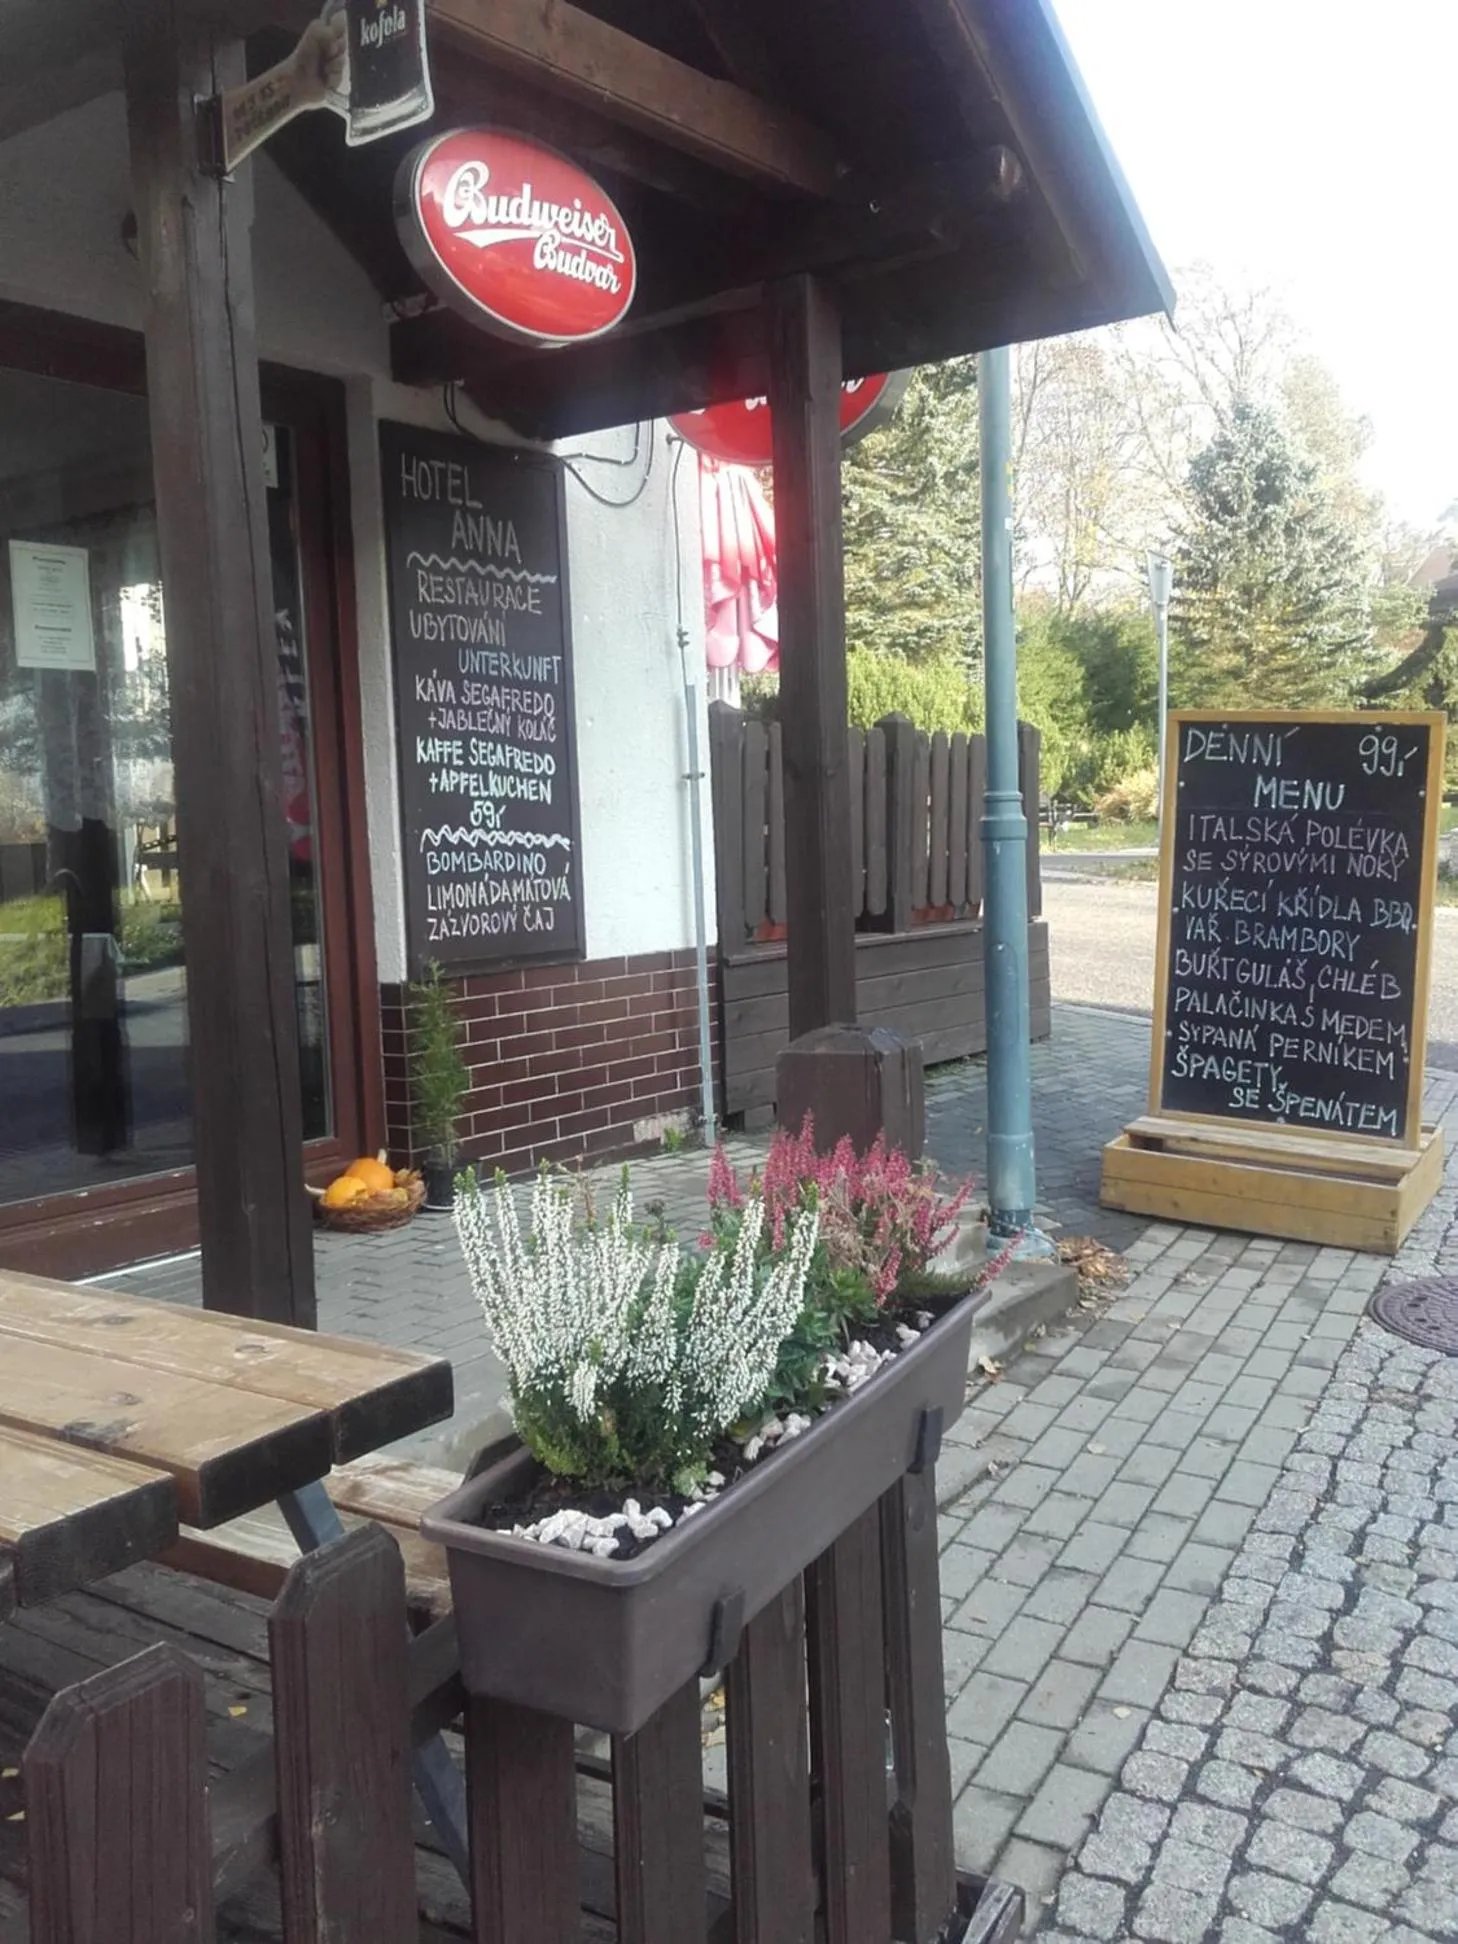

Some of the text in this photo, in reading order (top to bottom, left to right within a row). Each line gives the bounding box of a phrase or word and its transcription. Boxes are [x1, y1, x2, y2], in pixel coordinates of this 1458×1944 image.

[360, 5, 406, 48] kofola
[443, 161, 616, 252] Budweiser
[533, 231, 621, 294] Budvar
[401, 452, 482, 509] HOTEL
[452, 509, 521, 565] ANNA
[417, 569, 542, 615] RESTAURACE
[409, 610, 507, 647] UBYTOVÁNÍ
[458, 648, 562, 684] UNTERKUNFT
[415, 668, 554, 717] KÁVA SEGAFREDO
[517, 715, 557, 743] KOLÁČ
[1183, 726, 1300, 767] DENNÍ
[416, 736, 556, 776] KAFFE SEGAFREDO
[1253, 775, 1345, 811] MENU
[1188, 812, 1410, 859] ITALSKÁ POLÉVKA
[427, 850, 547, 875] BOMBARDINO
[1182, 842, 1406, 882] SE SÝROVÝMI NOKY
[427, 903, 554, 941] ZÁZVOROVÝ ČAJ
[1181, 876, 1414, 934] KUŘECÍ KŘÍDLA BBQ
[1235, 919, 1361, 962] BRAMBORY
[1317, 958, 1402, 1000] CHLÉB
[1174, 985, 1298, 1027] PALAČINKA
[1300, 1004, 1316, 1029] S
[1171, 1043, 1283, 1093] ŠPAGETY
[1177, 1019, 1396, 1081] SYPANÁ PERNÍKEM
[1228, 1080, 1399, 1138] SE ŠPENÁTEM
